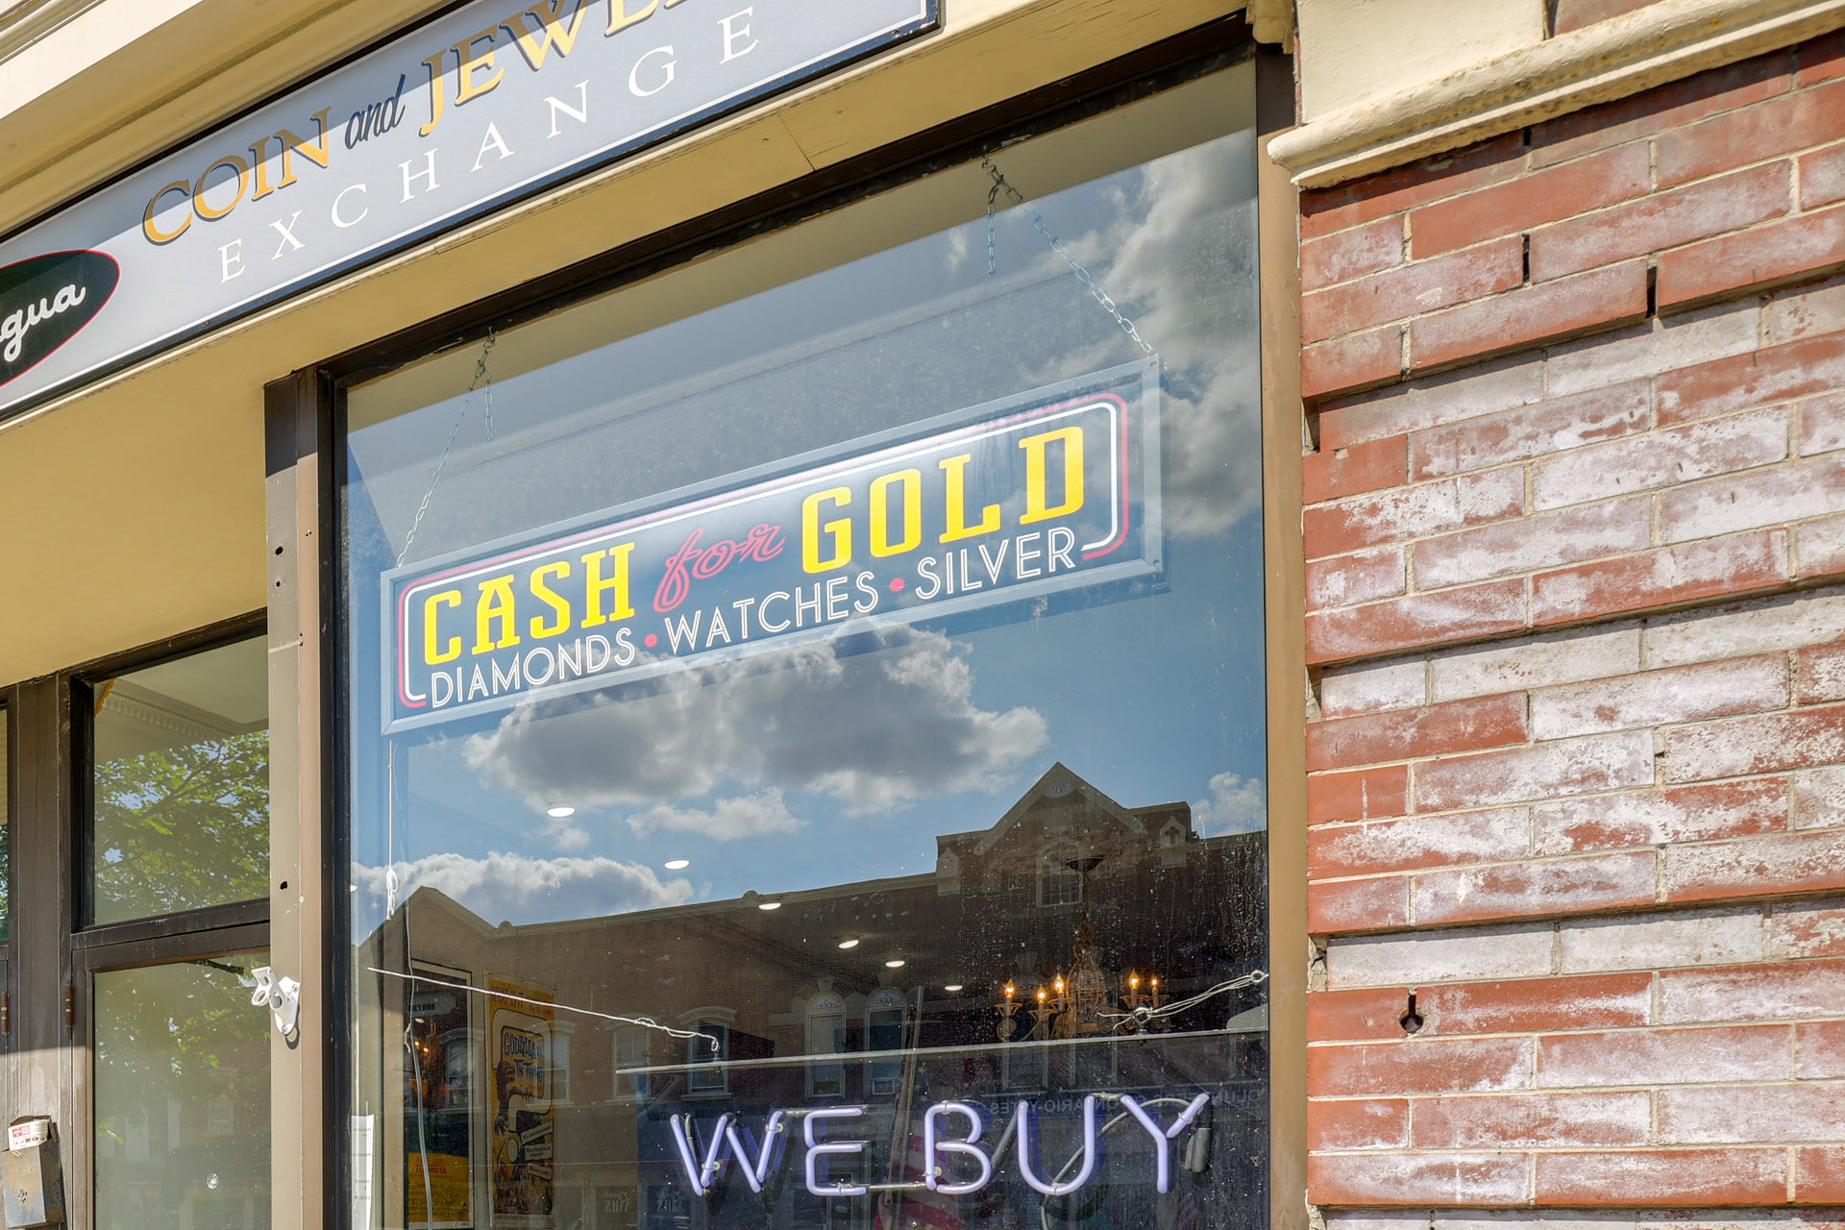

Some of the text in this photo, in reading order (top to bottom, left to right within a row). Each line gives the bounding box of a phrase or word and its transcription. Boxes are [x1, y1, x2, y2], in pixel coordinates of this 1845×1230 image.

[142, 106, 331, 247] COIN
[343, 77, 405, 150] and
[221, 6, 761, 284] EXCHANGE
[423, 425, 1087, 667] CASH for GOLD
[430, 526, 1077, 710] DIAMONDS WATCHES SILVER
[669, 1092, 1211, 1197] WE BUY
